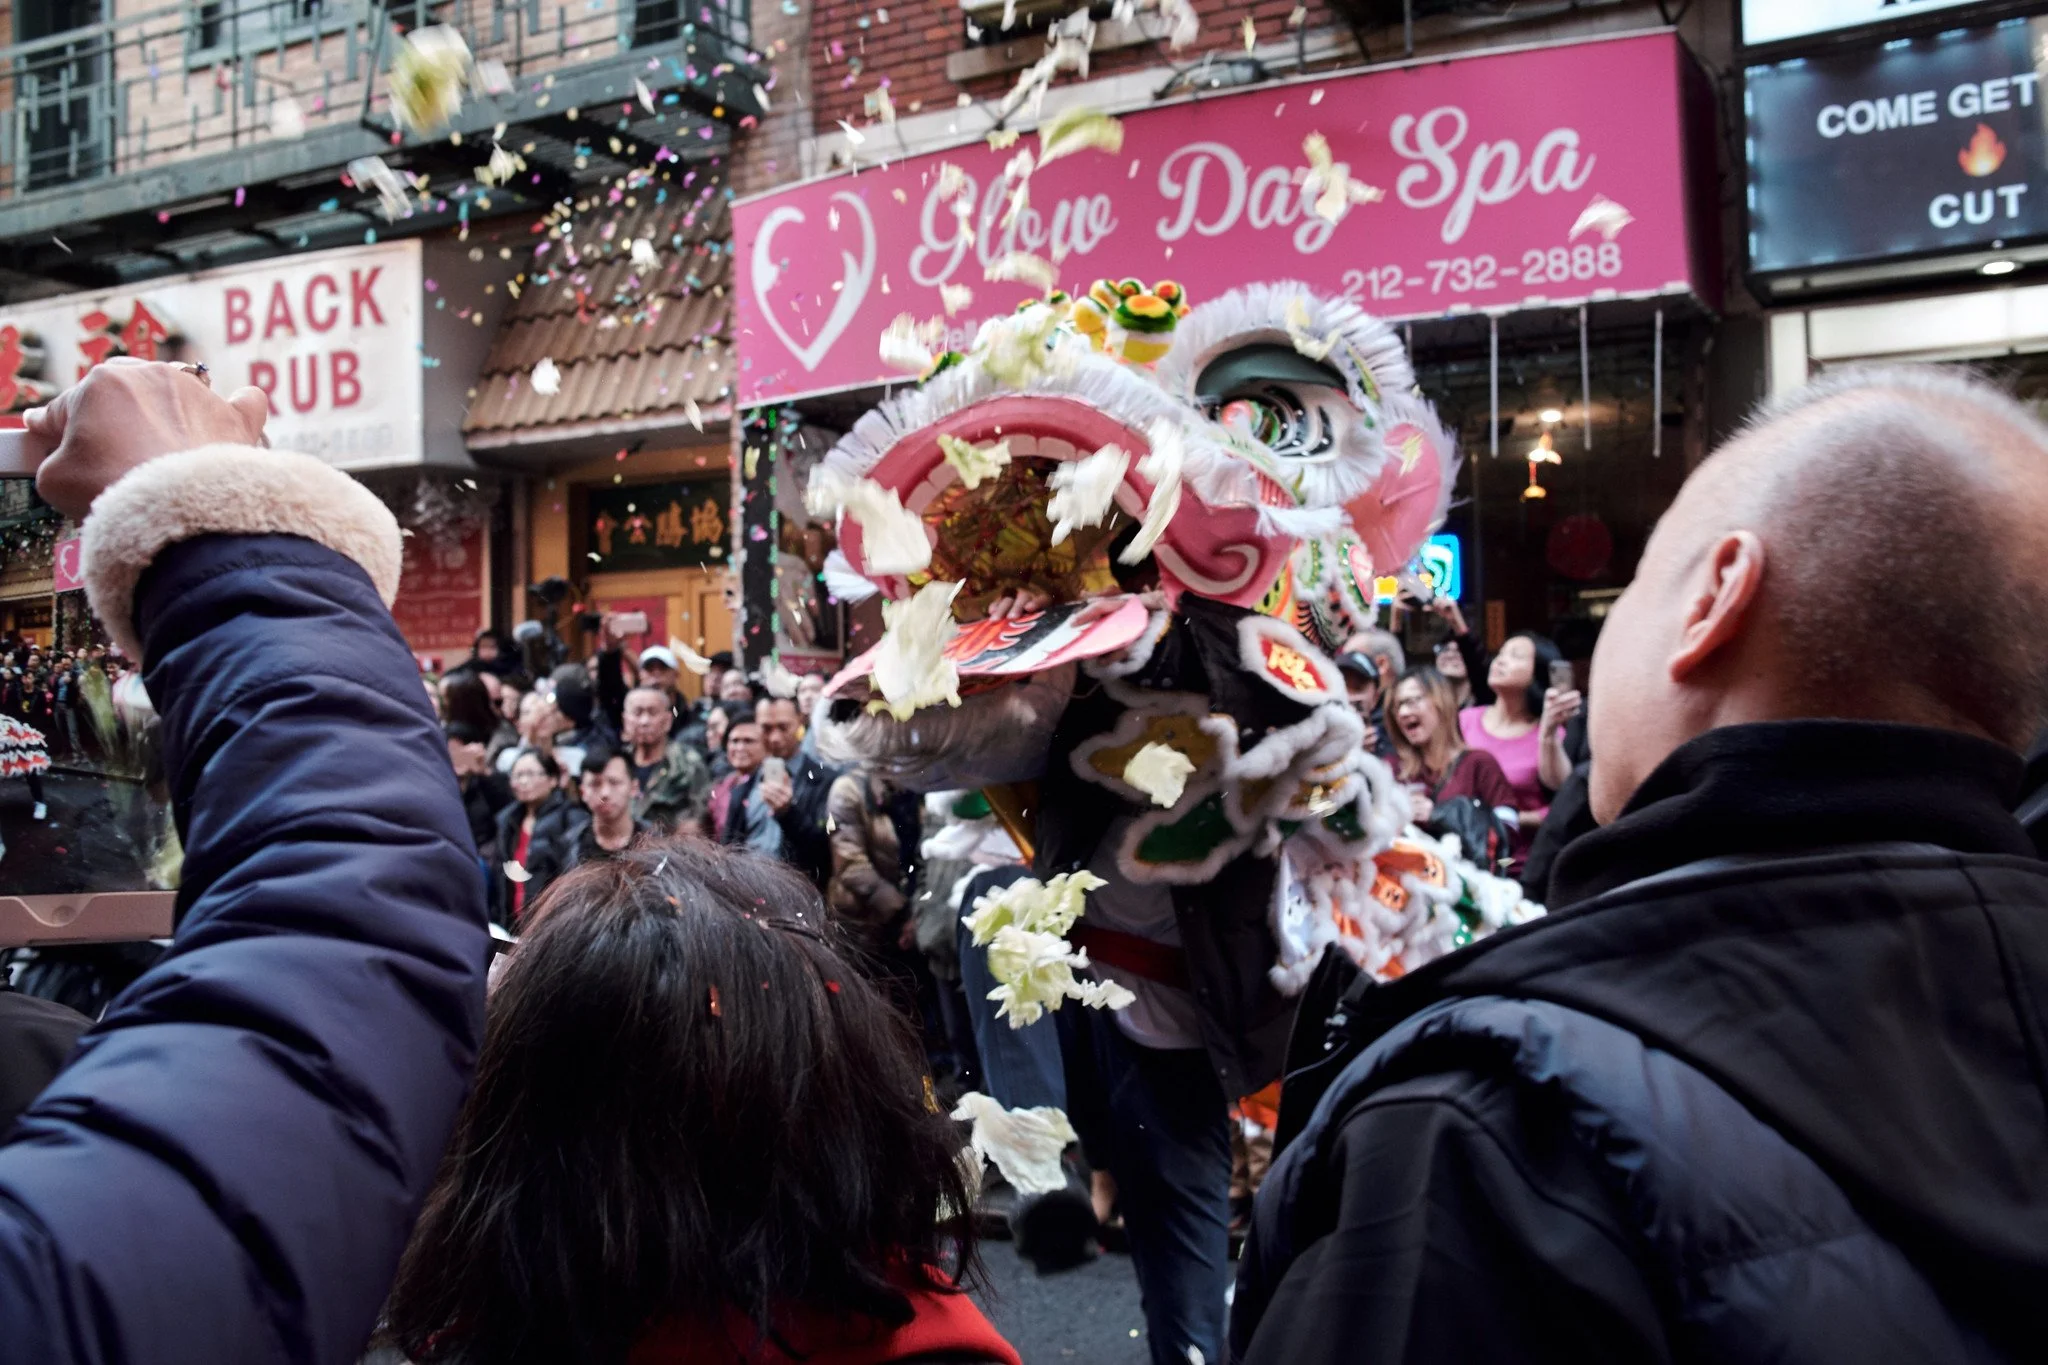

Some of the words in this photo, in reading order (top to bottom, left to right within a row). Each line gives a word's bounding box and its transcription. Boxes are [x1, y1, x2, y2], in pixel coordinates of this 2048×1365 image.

[1817, 90, 1938, 138] COME
[1949, 72, 2040, 119] GET
[1389, 106, 1597, 244] Spa
[1928, 183, 2029, 228] CUT
[224, 265, 388, 345] BACK
[1341, 242, 1623, 302] 212-732-2888
[249, 350, 363, 416] RUB
